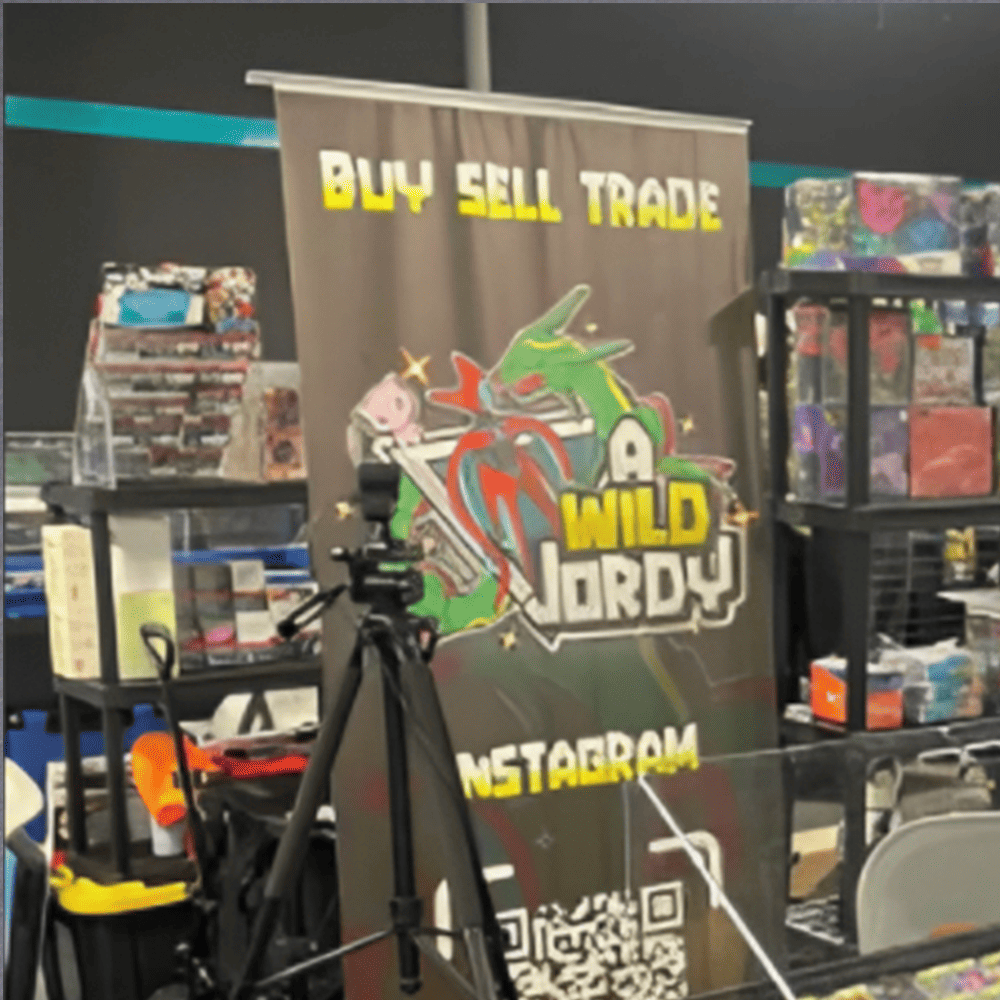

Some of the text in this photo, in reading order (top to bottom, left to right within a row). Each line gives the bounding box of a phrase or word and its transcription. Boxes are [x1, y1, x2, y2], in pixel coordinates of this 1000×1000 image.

[319, 150, 722, 231] BUY SELL TRADE
[609, 416, 654, 482] A
[561, 480, 711, 551] WILD
[524, 535, 732, 624] JORDY
[455, 722, 699, 799] NSTAGRAM
